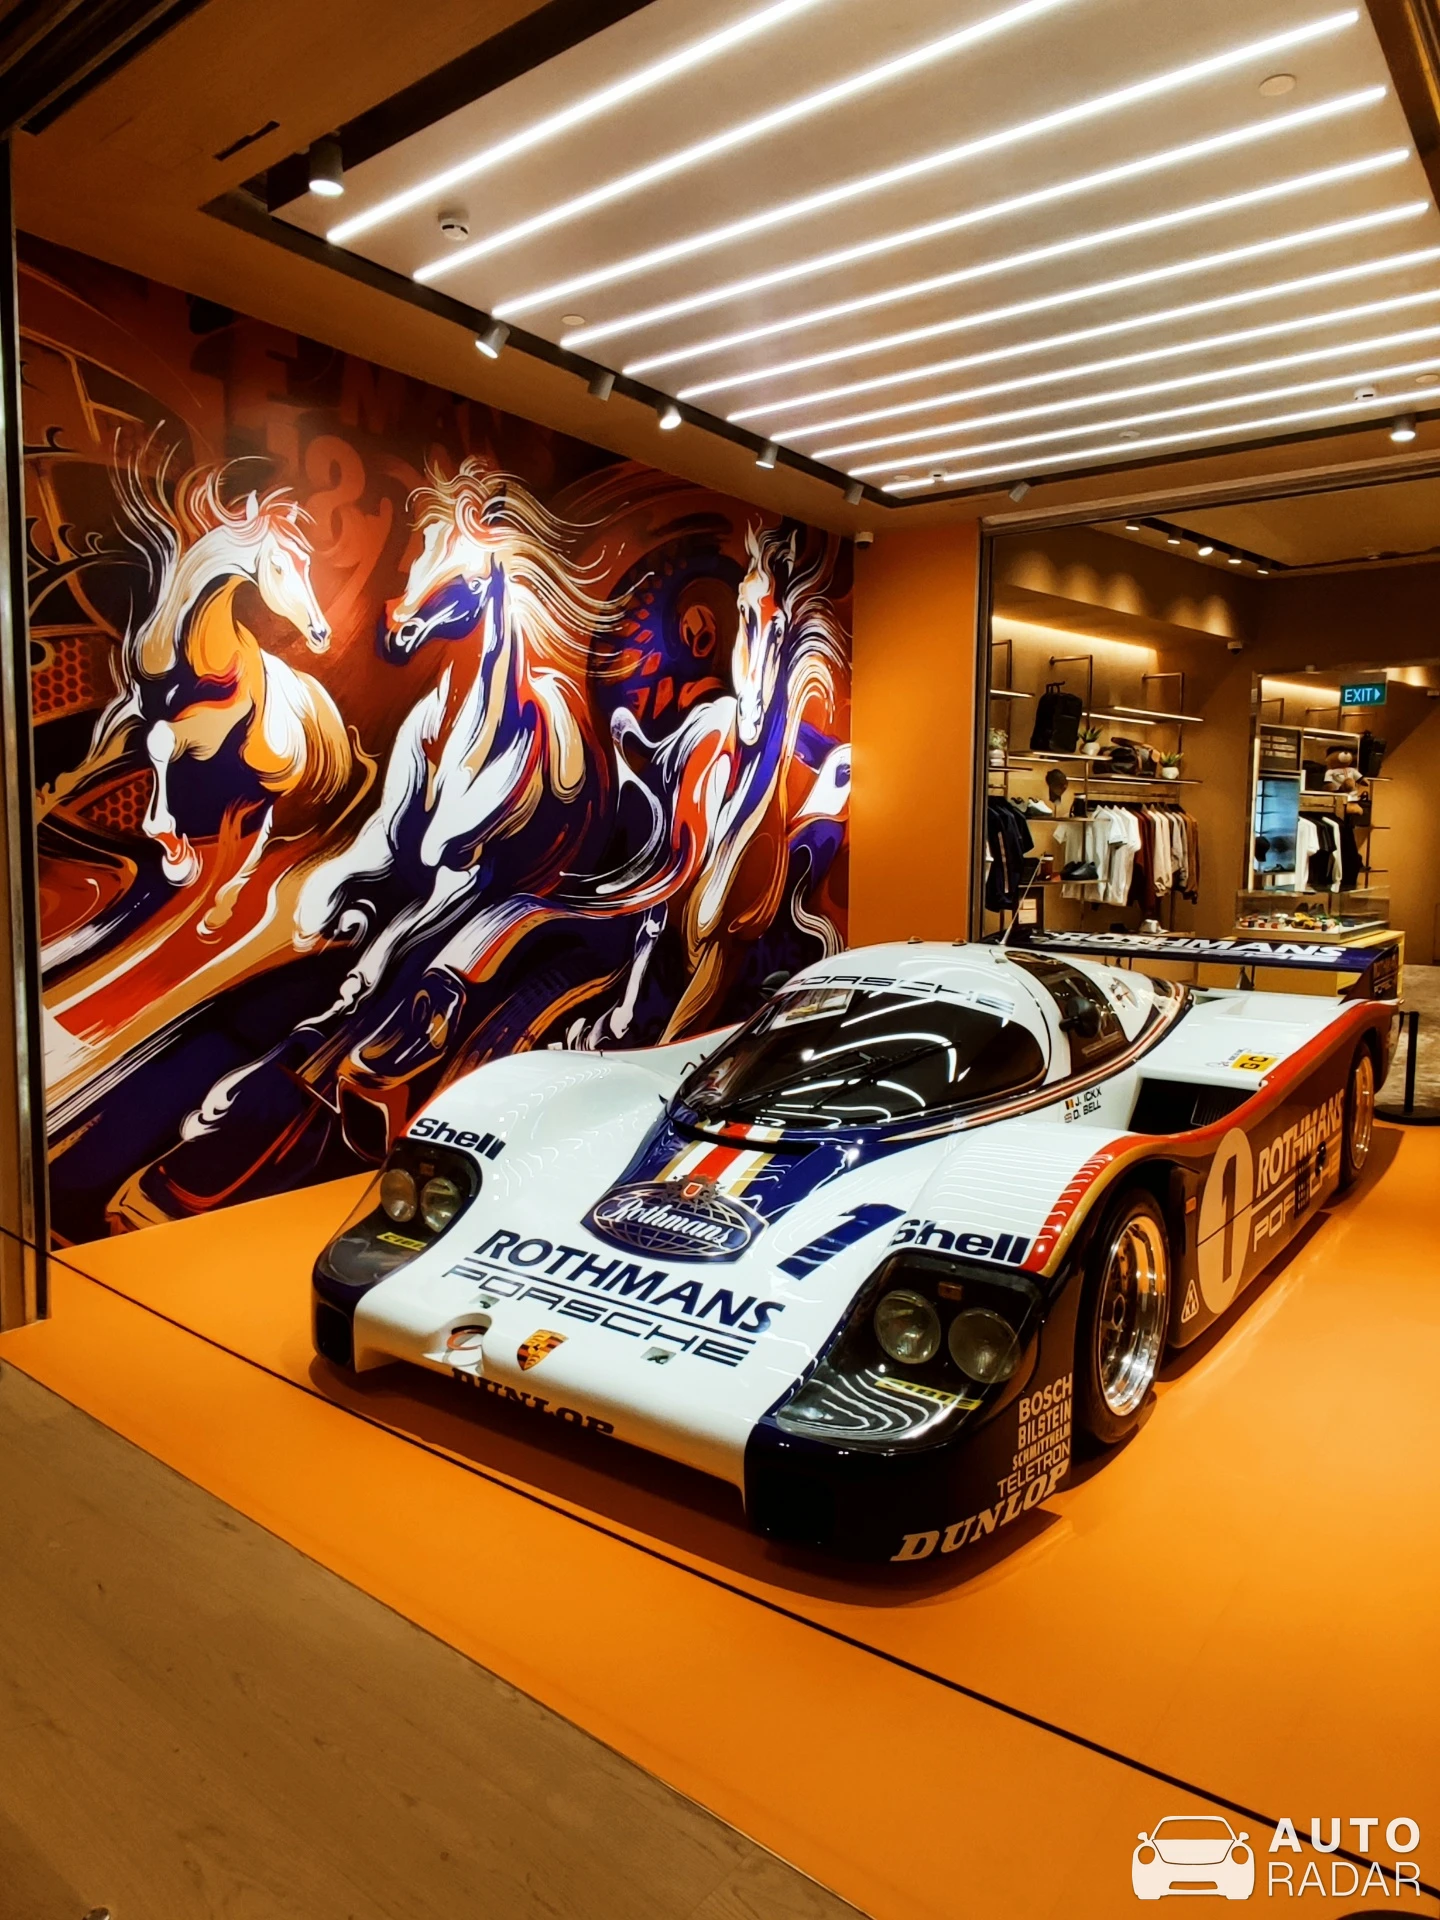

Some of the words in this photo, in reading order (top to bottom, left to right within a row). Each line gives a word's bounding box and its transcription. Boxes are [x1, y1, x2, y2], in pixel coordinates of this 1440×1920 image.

[1344, 687, 1373, 702] EXIT
[1073, 1109, 1081, 1120] D.
[1083, 1099, 1102, 1115] BELL
[1075, 1096, 1082, 1107] J.
[1083, 1086, 1102, 1102] ICKX
[409, 1116, 506, 1161] Shell
[1256, 1088, 1345, 1199] ROTHMANS
[601, 1197, 734, 1249] Rothmans
[889, 1218, 1031, 1265] Shell
[474, 1229, 786, 1334] ROTHMANS
[441, 1264, 757, 1368] PORSCHE
[1018, 1372, 1073, 1425] BOSCH
[1018, 1397, 1073, 1450] BILSTEIN
[997, 1437, 1071, 1498] TELETRON
[890, 1458, 1070, 1562] DUNLOP
